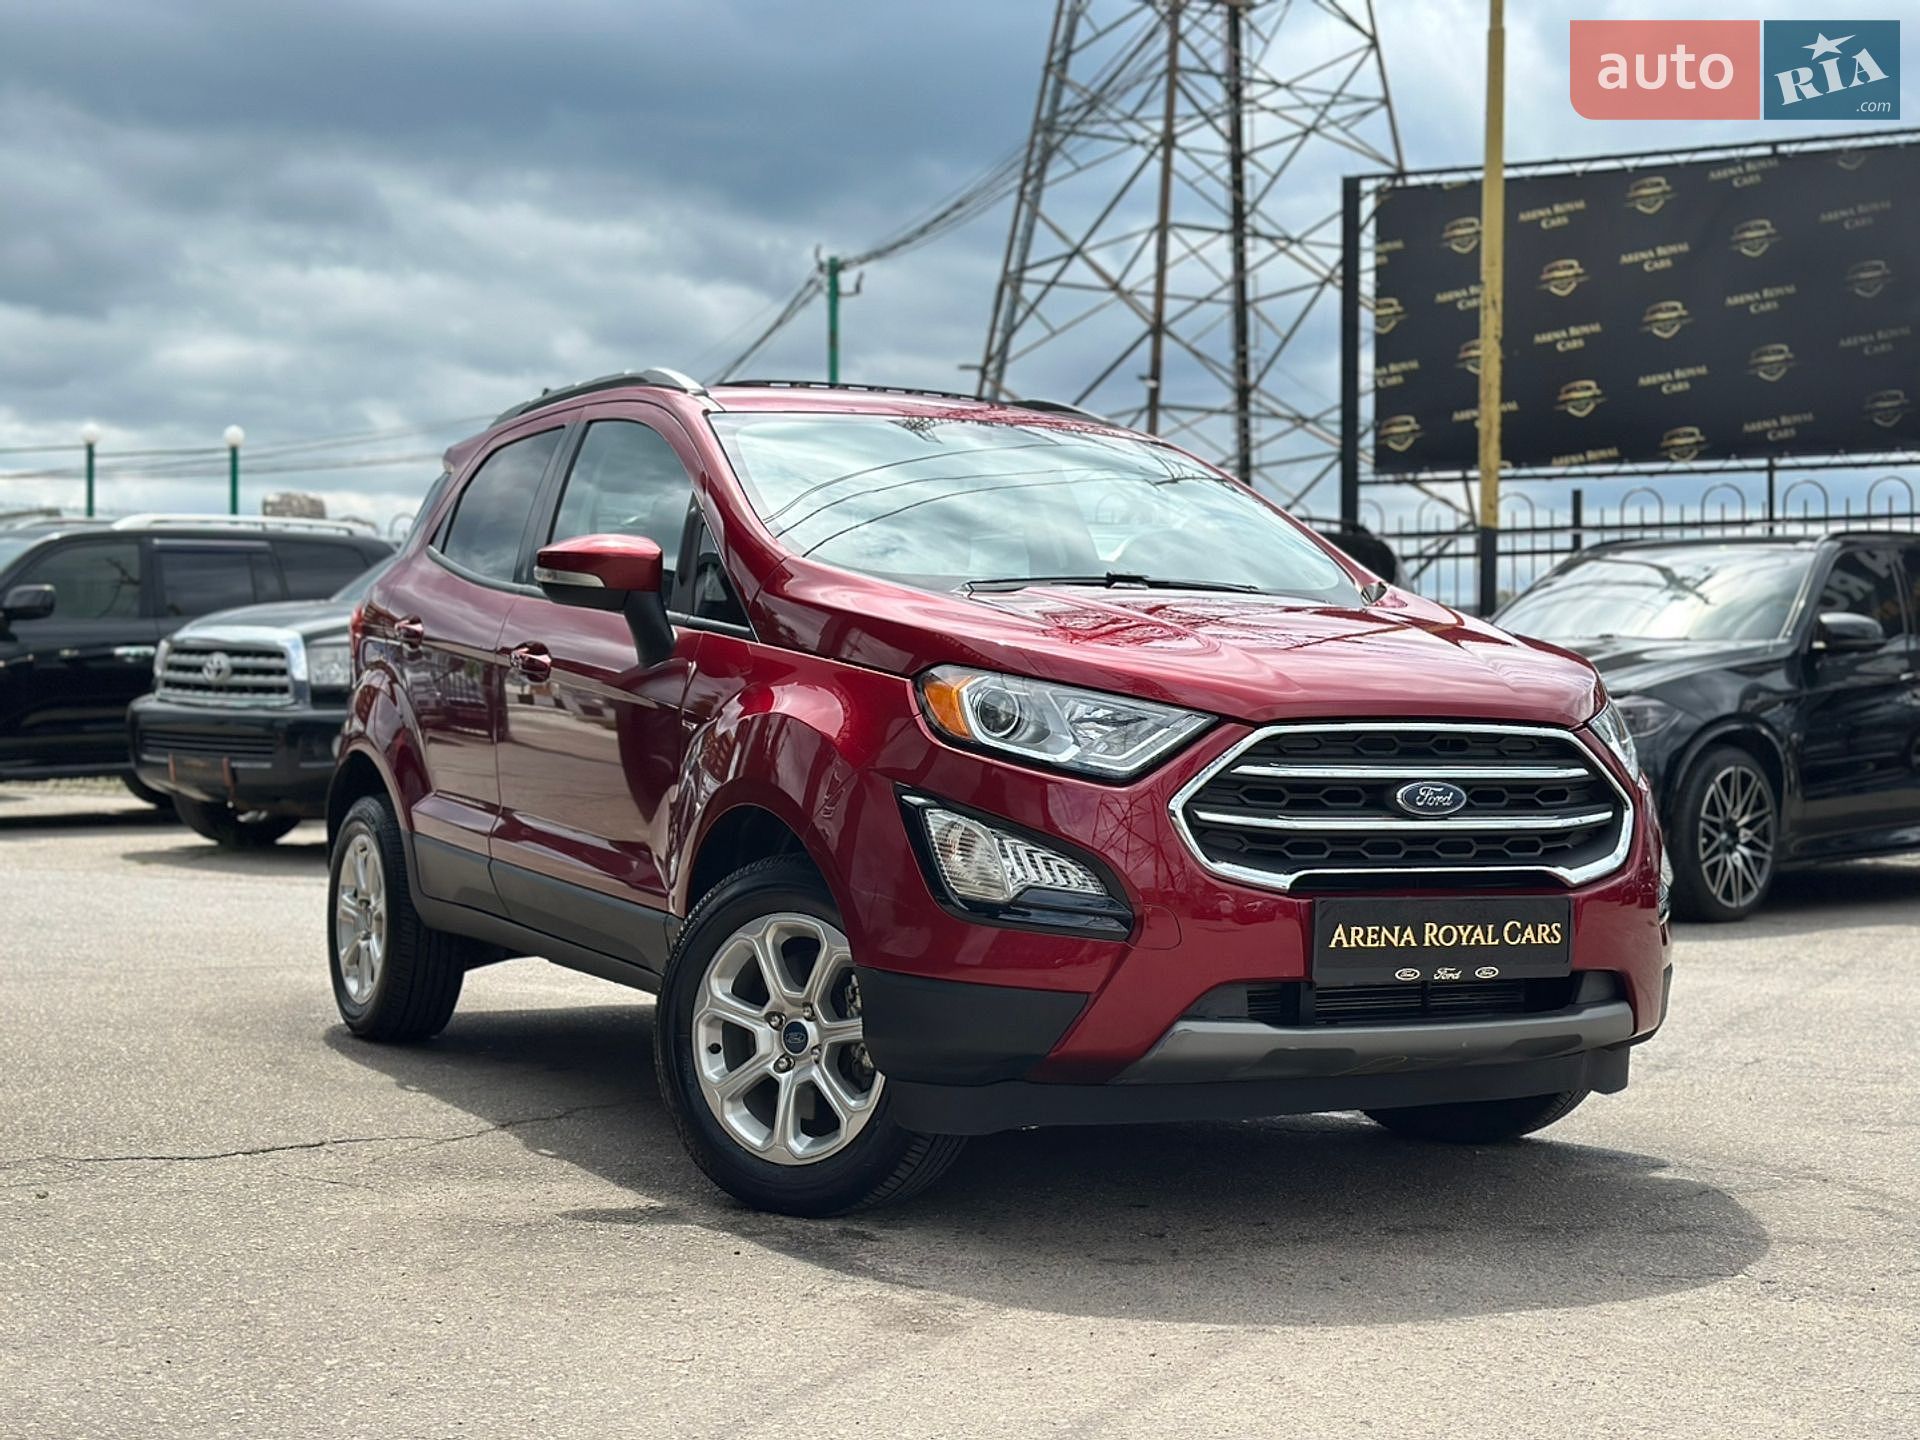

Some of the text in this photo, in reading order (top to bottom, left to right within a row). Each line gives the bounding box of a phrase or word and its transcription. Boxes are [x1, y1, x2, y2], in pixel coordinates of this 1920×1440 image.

[1416, 786, 1454, 806] Ford
[1329, 920, 1562, 948] ARENA ROYAL CARS
[1434, 967, 1462, 980] Ford
